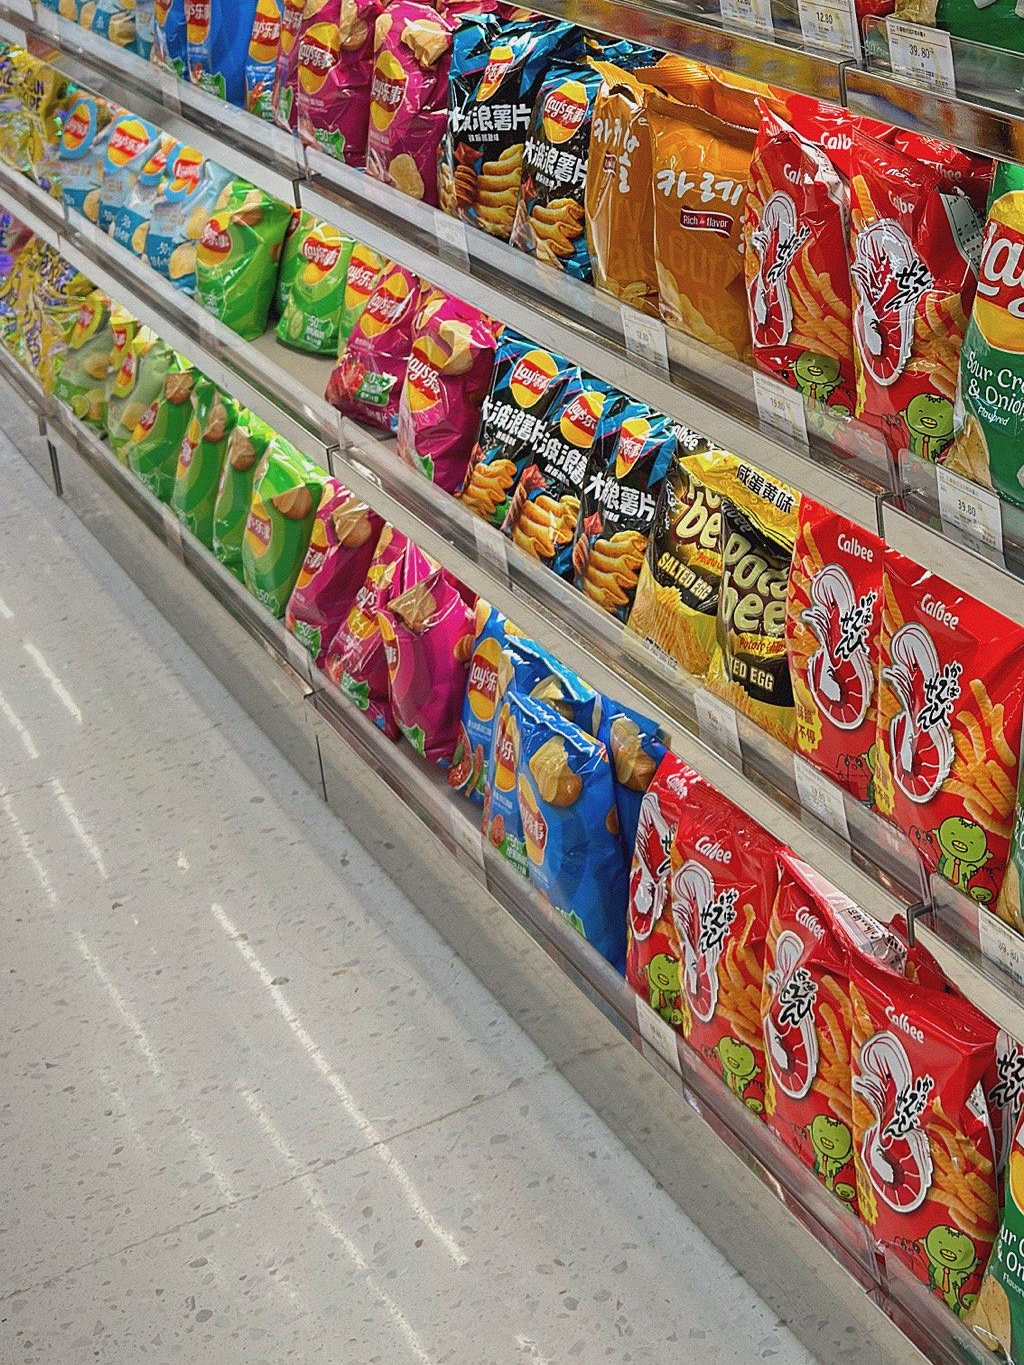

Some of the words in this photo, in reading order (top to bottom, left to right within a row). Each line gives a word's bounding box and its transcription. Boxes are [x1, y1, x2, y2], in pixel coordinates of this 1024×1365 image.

[815, 11, 833, 25] 12.80
[908, 43, 932, 60] 39.80
[544, 97, 566, 119] Lay's
[563, 103, 586, 124] 乐事
[683, 213, 699, 226] Rich
[706, 215, 729, 229] flavor
[966, 351, 993, 382] Sour
[968, 378, 980, 398] &
[978, 405, 1010, 426] Flavored
[735, 463, 796, 514] 咸蛋黄味
[956, 499, 977, 517] 39.80
[837, 533, 874, 563] Calbee
[659, 553, 691, 587] SALTED
[691, 575, 712, 600] EGG
[920, 592, 960, 631] Calbee
[750, 664, 774, 691] EGG
[694, 834, 732, 865] Calbee
[795, 905, 825, 939] Calbee
[884, 1006, 925, 1045] Calbee
